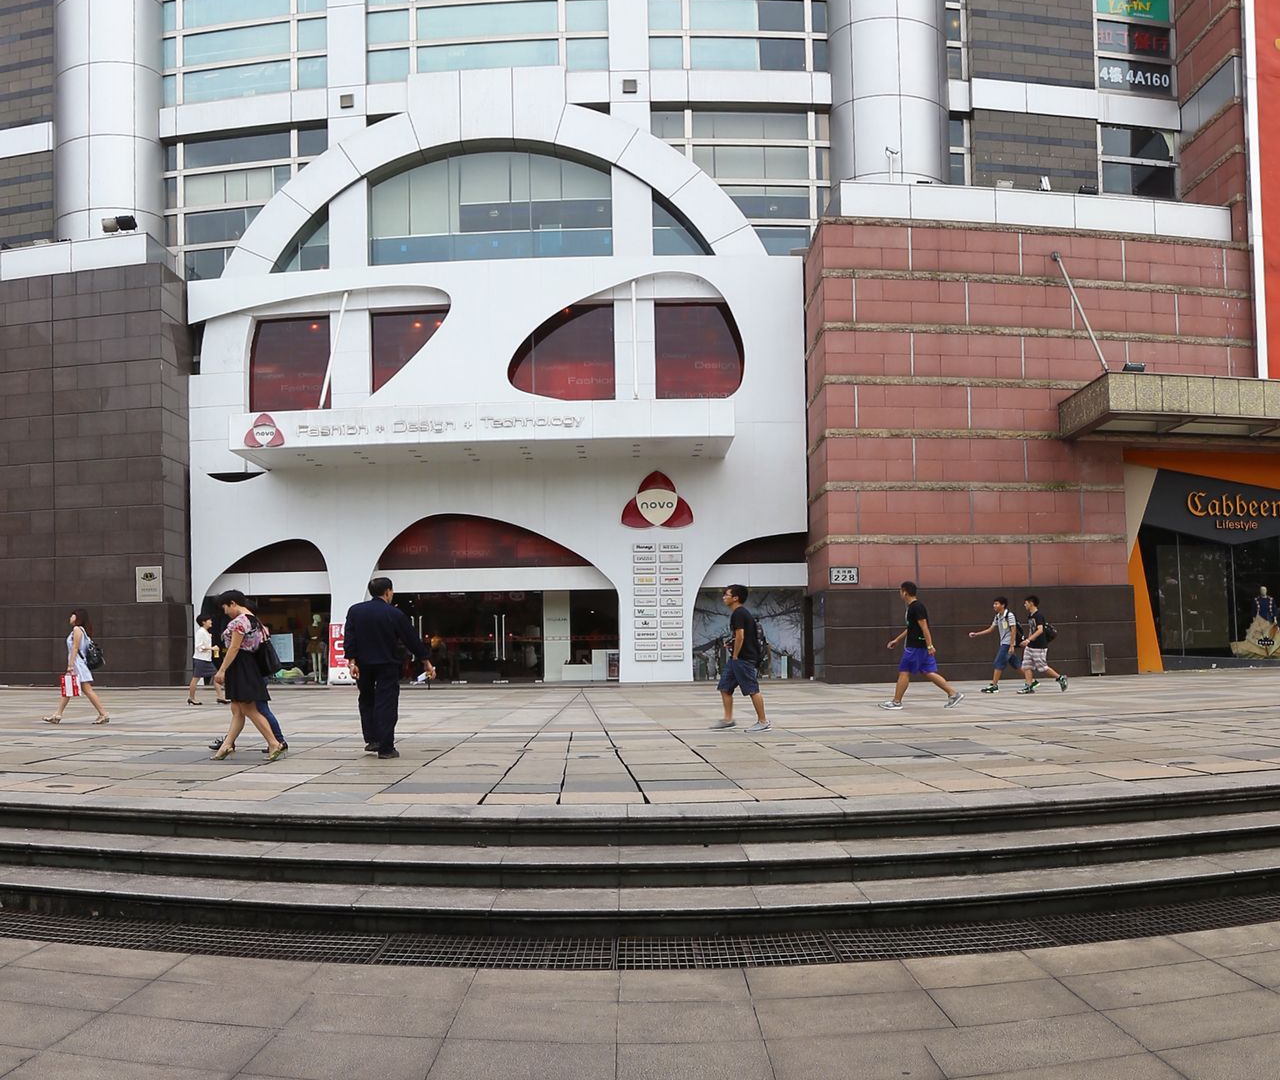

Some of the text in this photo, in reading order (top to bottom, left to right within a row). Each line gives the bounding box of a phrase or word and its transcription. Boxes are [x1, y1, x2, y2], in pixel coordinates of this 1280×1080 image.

[1125, 69, 1170, 87] 4A160
[296, 423, 369, 438] Fashion
[391, 420, 456, 434] Design
[479, 414, 586, 429] Technology
[640, 501, 674, 509] novo
[1216, 520, 1258, 531] Lifestyle
